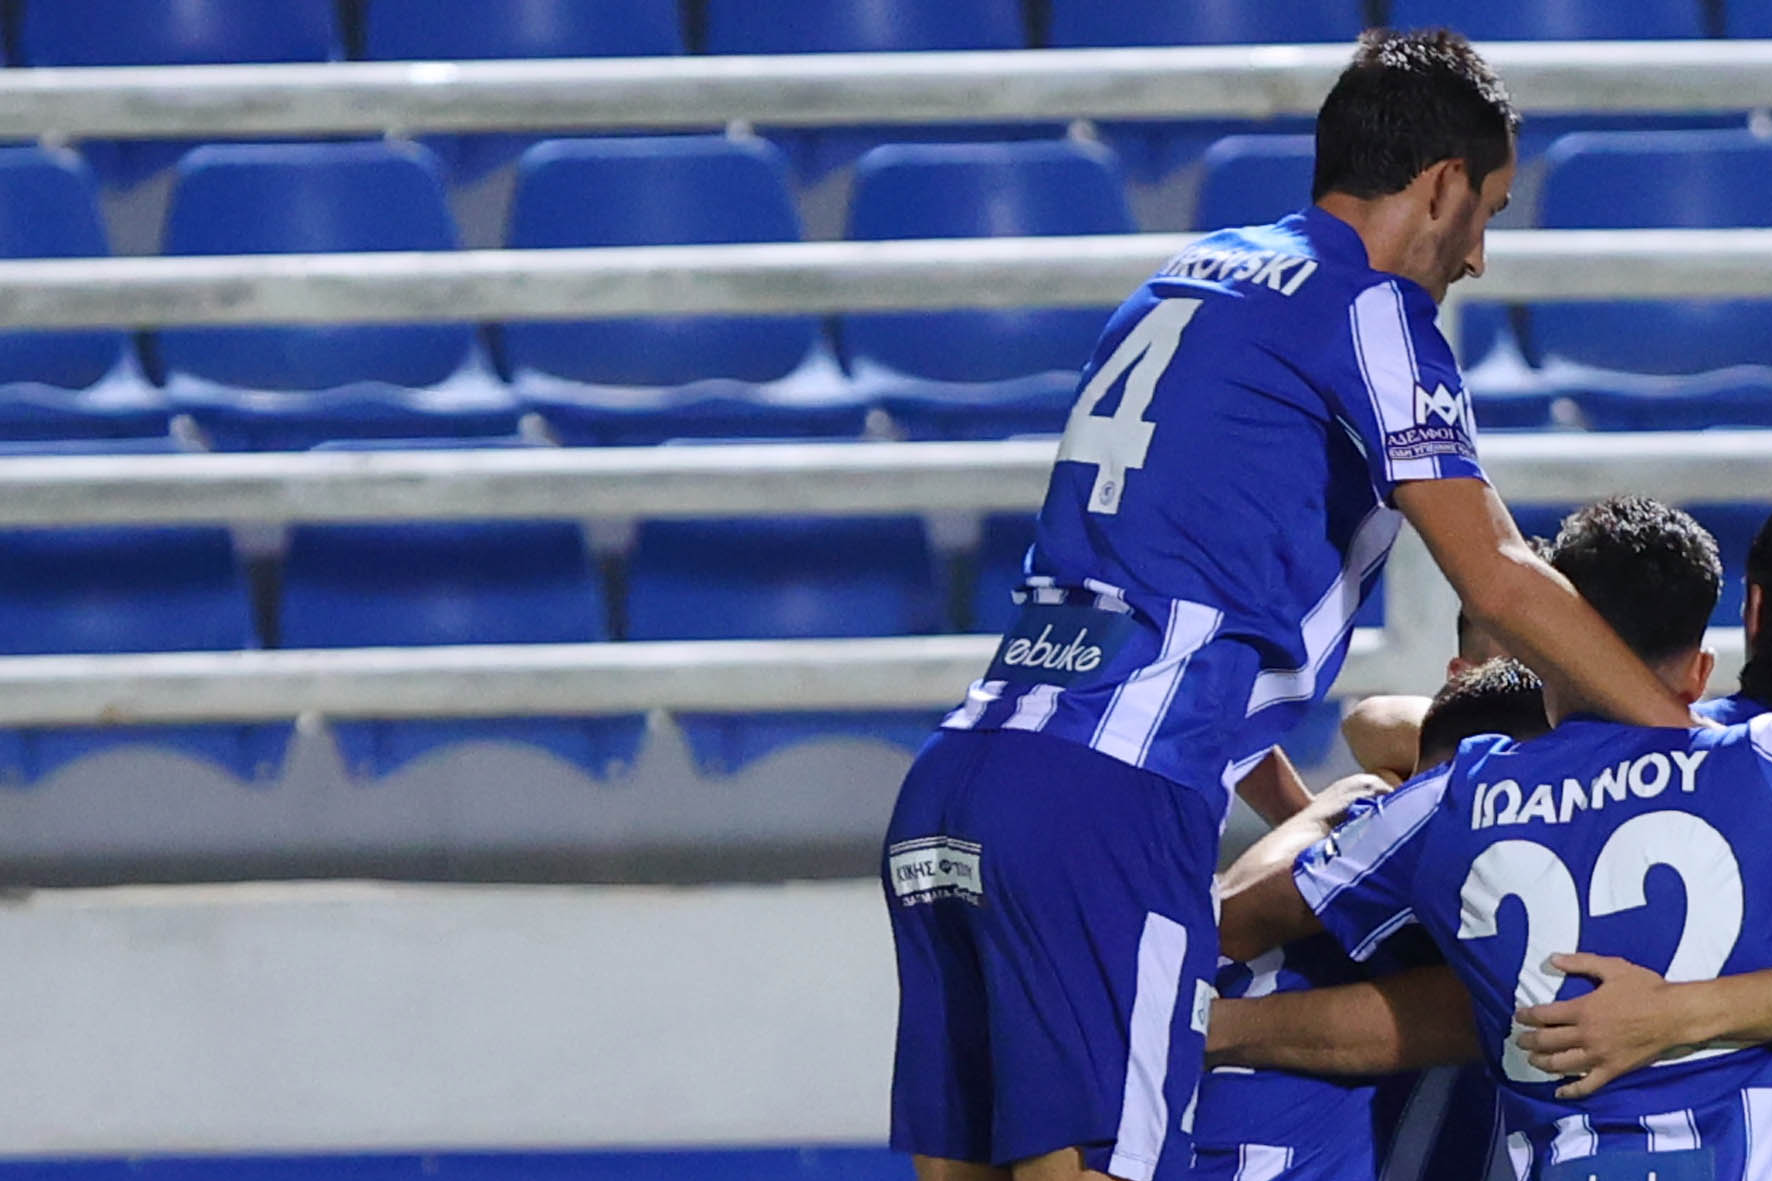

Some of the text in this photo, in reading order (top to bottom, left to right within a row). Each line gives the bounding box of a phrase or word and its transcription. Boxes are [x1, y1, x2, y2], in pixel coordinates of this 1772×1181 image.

[1056, 298, 1204, 515] 4
[1004, 623, 1101, 672] ebuke
[1471, 750, 1709, 830] ΙΩΑΝΝΟΥ
[1457, 810, 1744, 1084] 22
